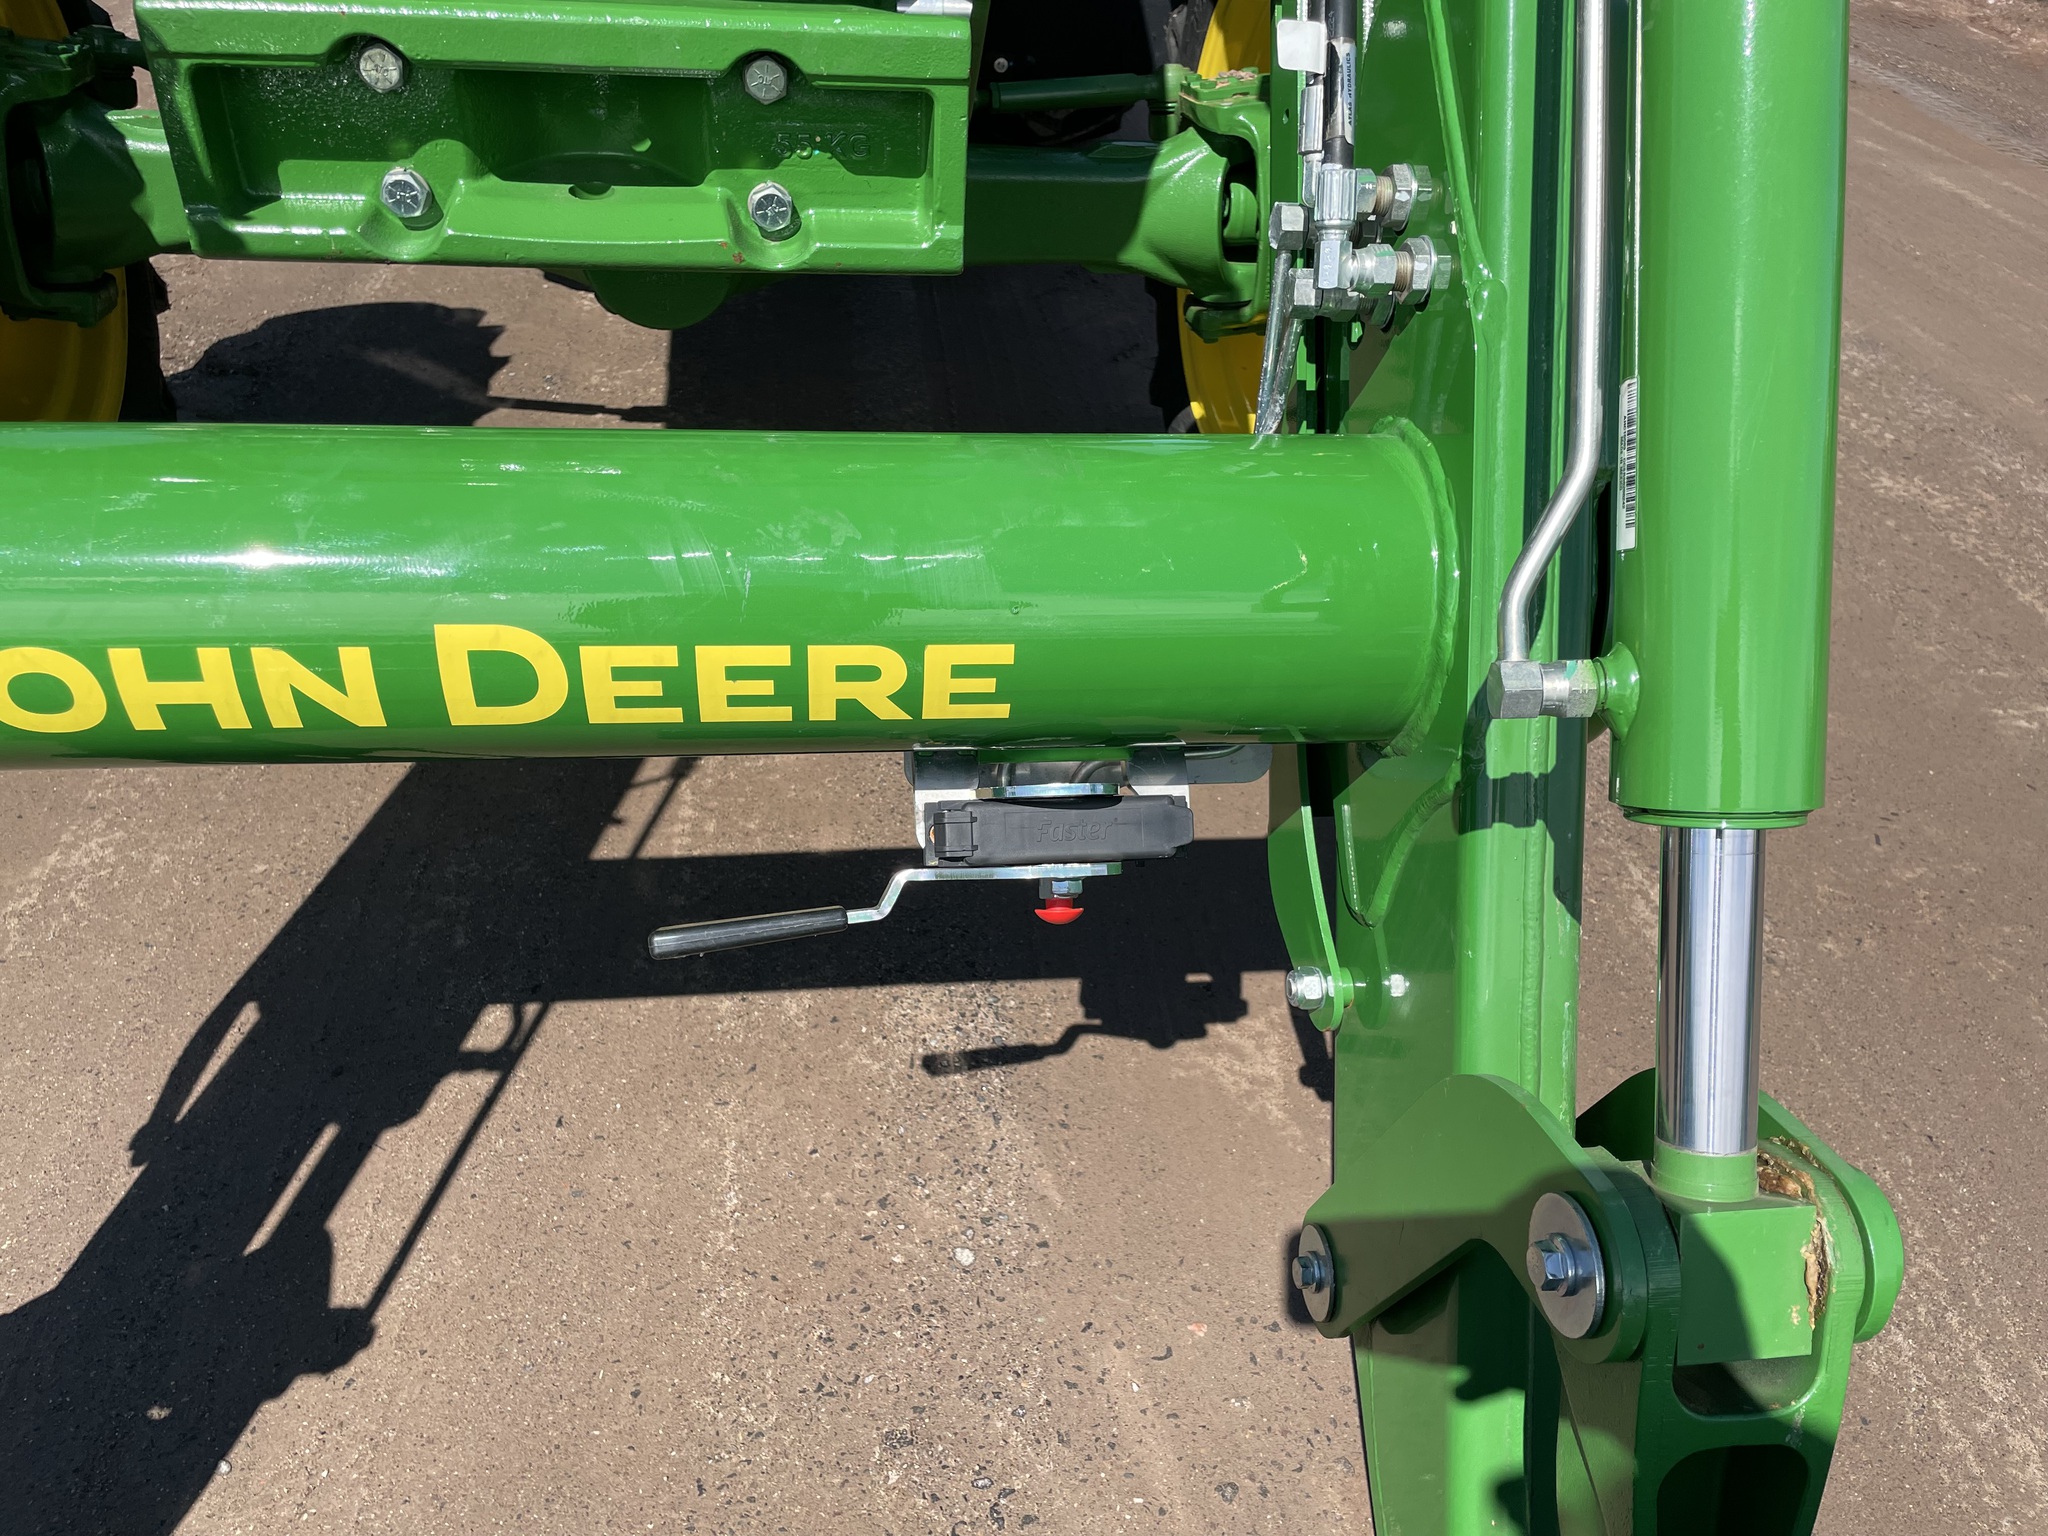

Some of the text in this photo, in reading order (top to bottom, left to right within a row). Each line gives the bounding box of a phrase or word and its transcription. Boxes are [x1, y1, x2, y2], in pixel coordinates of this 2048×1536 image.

[775, 131, 871, 160] 55 KG
[434, 624, 1015, 726] DEERE
[1036, 819, 1113, 842] Faster
